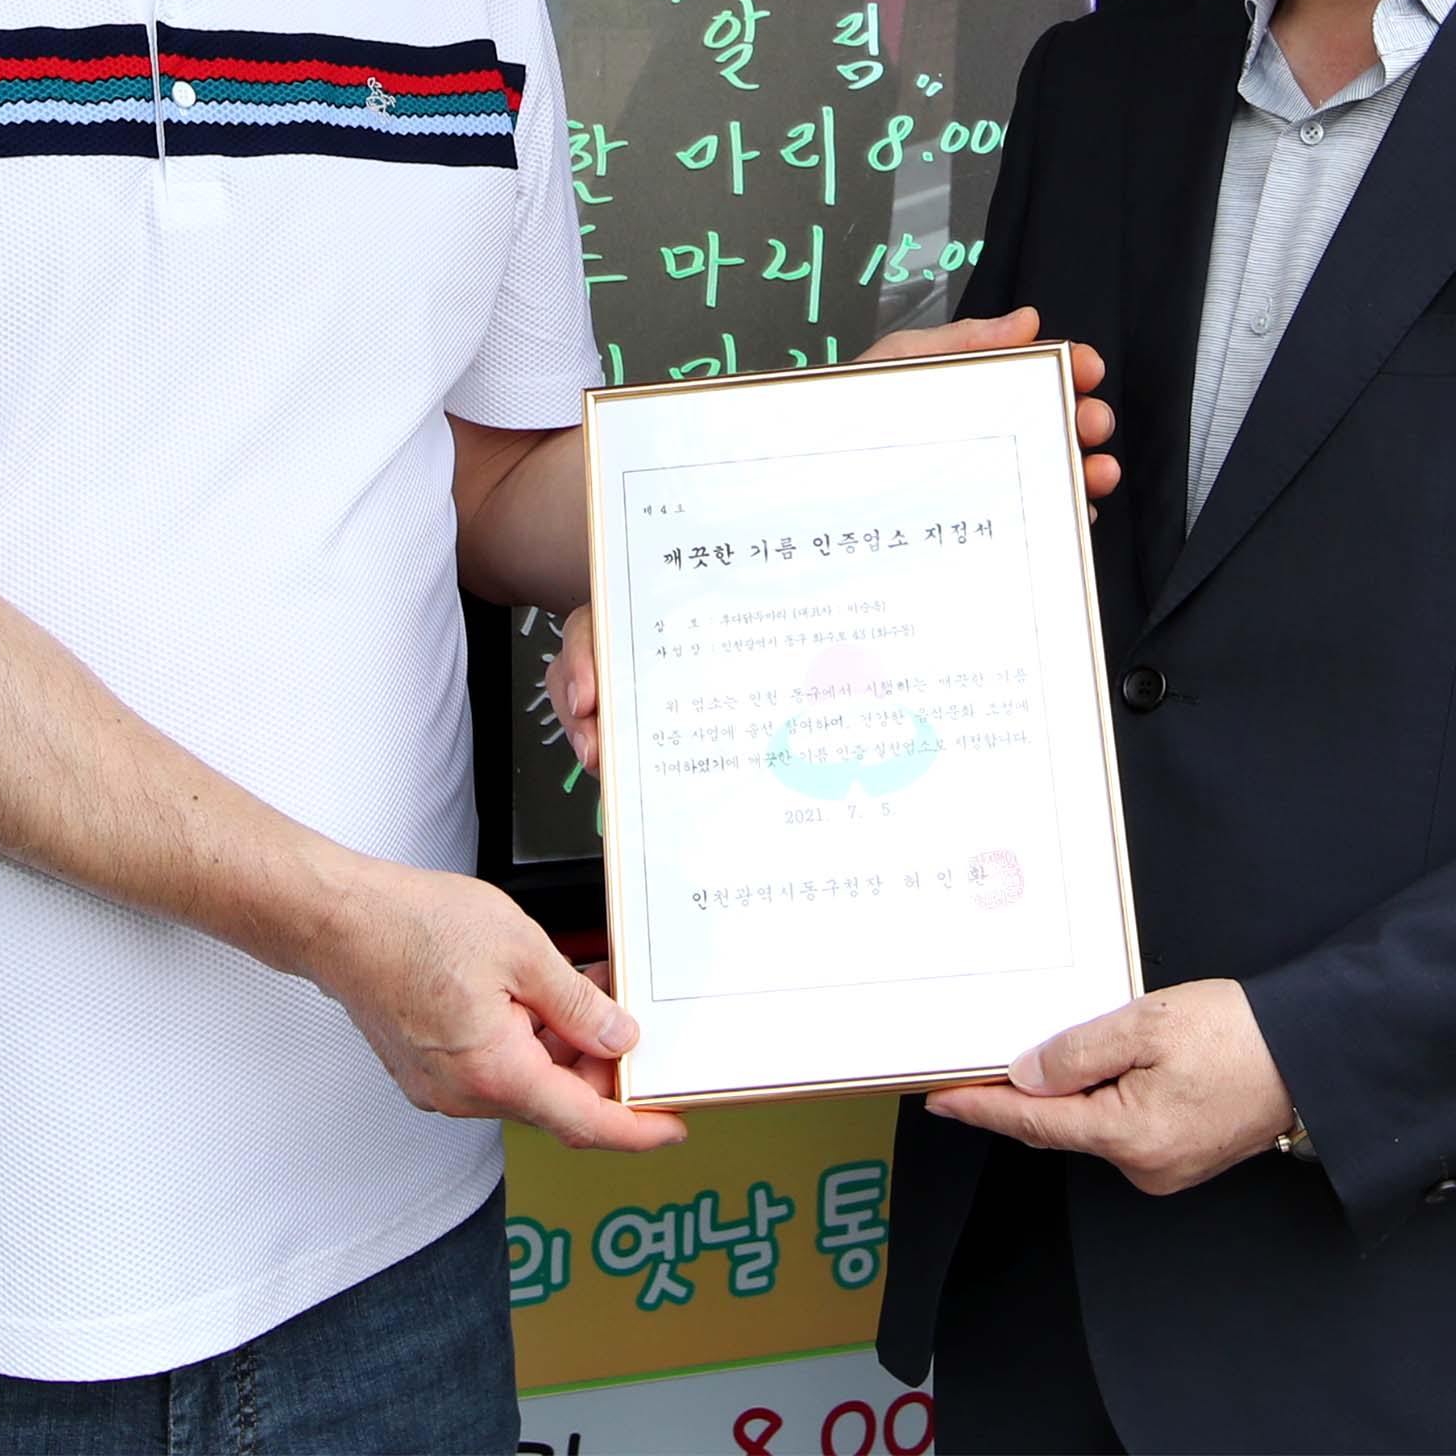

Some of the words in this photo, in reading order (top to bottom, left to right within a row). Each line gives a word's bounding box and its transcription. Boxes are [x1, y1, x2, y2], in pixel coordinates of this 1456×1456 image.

[676, 106, 835, 206] 마리
[660, 224, 824, 323] 마리
[663, 541, 735, 571] 깨끗한
[749, 536, 797, 564] 기름
[811, 528, 909, 558] 인증업소
[923, 518, 993, 547] 지정서
[690, 696, 739, 713] 업소는
[748, 689, 778, 706] 인천
[790, 681, 852, 703] 동구에서
[651, 729, 683, 747] 인증
[593, 1181, 795, 1311] 옛날
